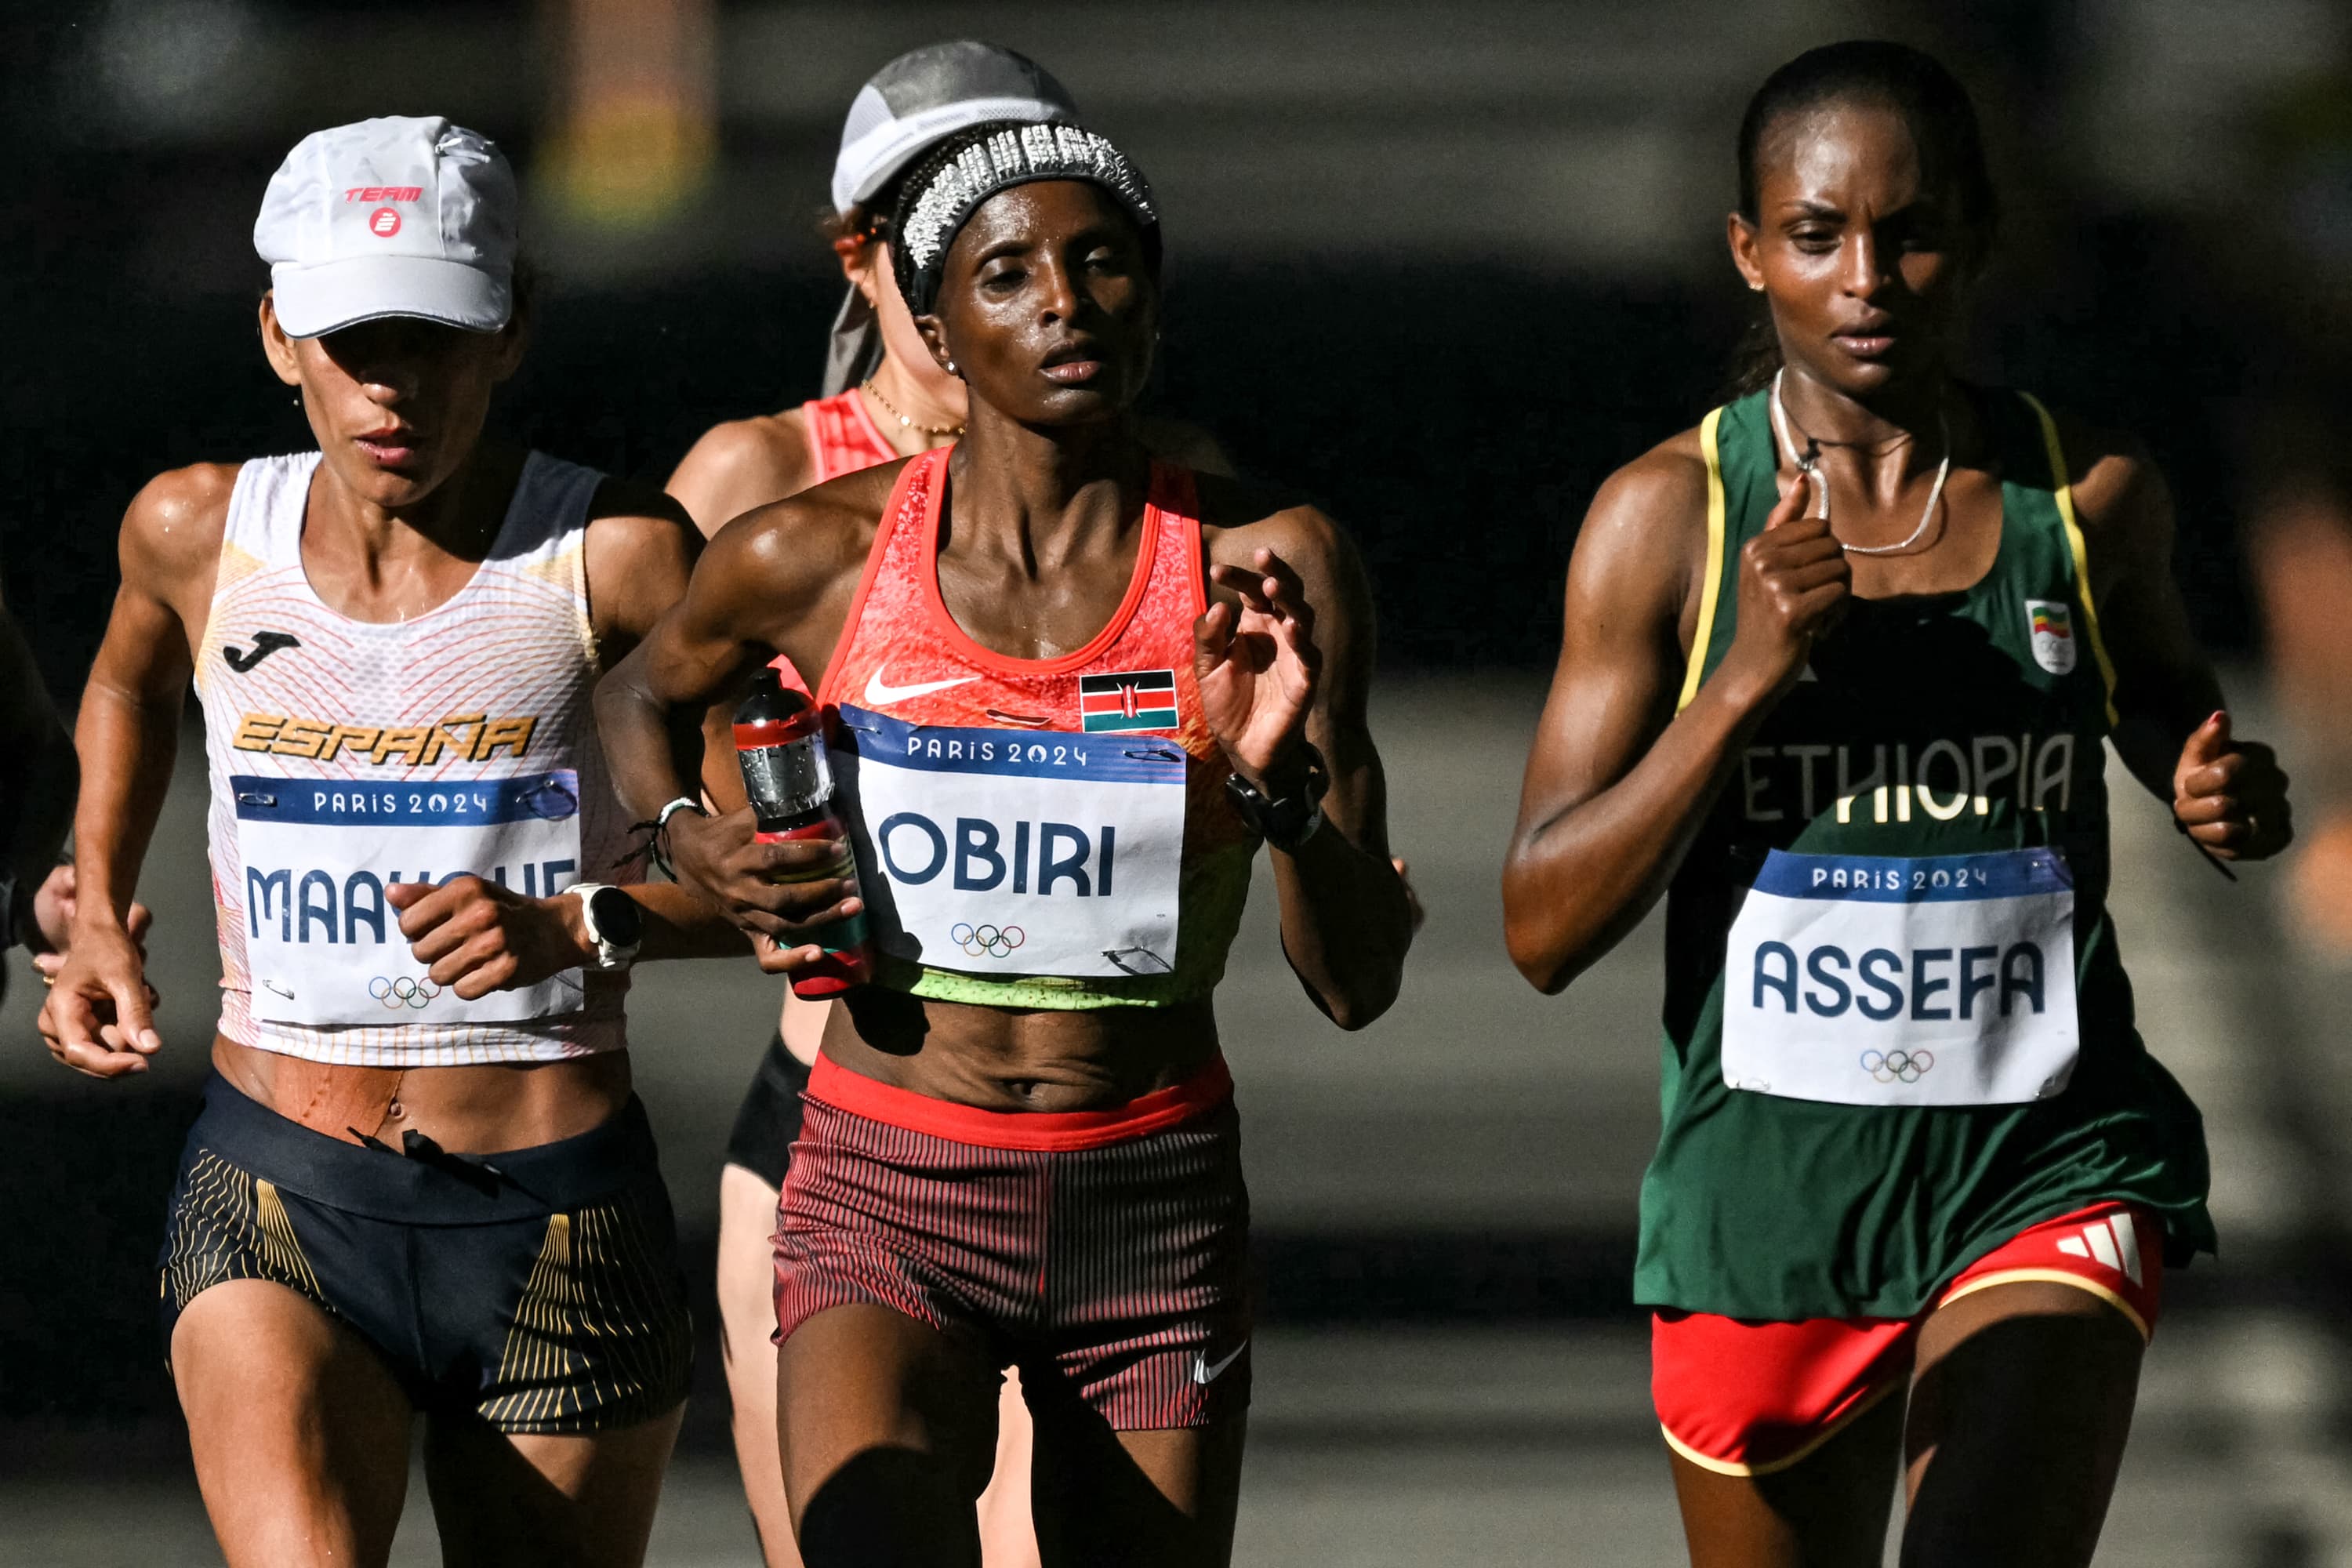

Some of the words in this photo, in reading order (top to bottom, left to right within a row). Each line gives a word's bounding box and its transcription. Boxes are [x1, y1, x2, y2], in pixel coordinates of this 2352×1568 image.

[345, 187, 423, 202] TEAM
[233, 713, 539, 766] ESPAÑA
[1007, 743, 1087, 767] 2024
[1743, 734, 2074, 824] ETHIOPIA
[408, 793, 488, 813] 2024
[879, 811, 1115, 897] OBIRI
[1913, 869, 1987, 891] 2024
[1753, 941, 2045, 1021] ASSEFA
